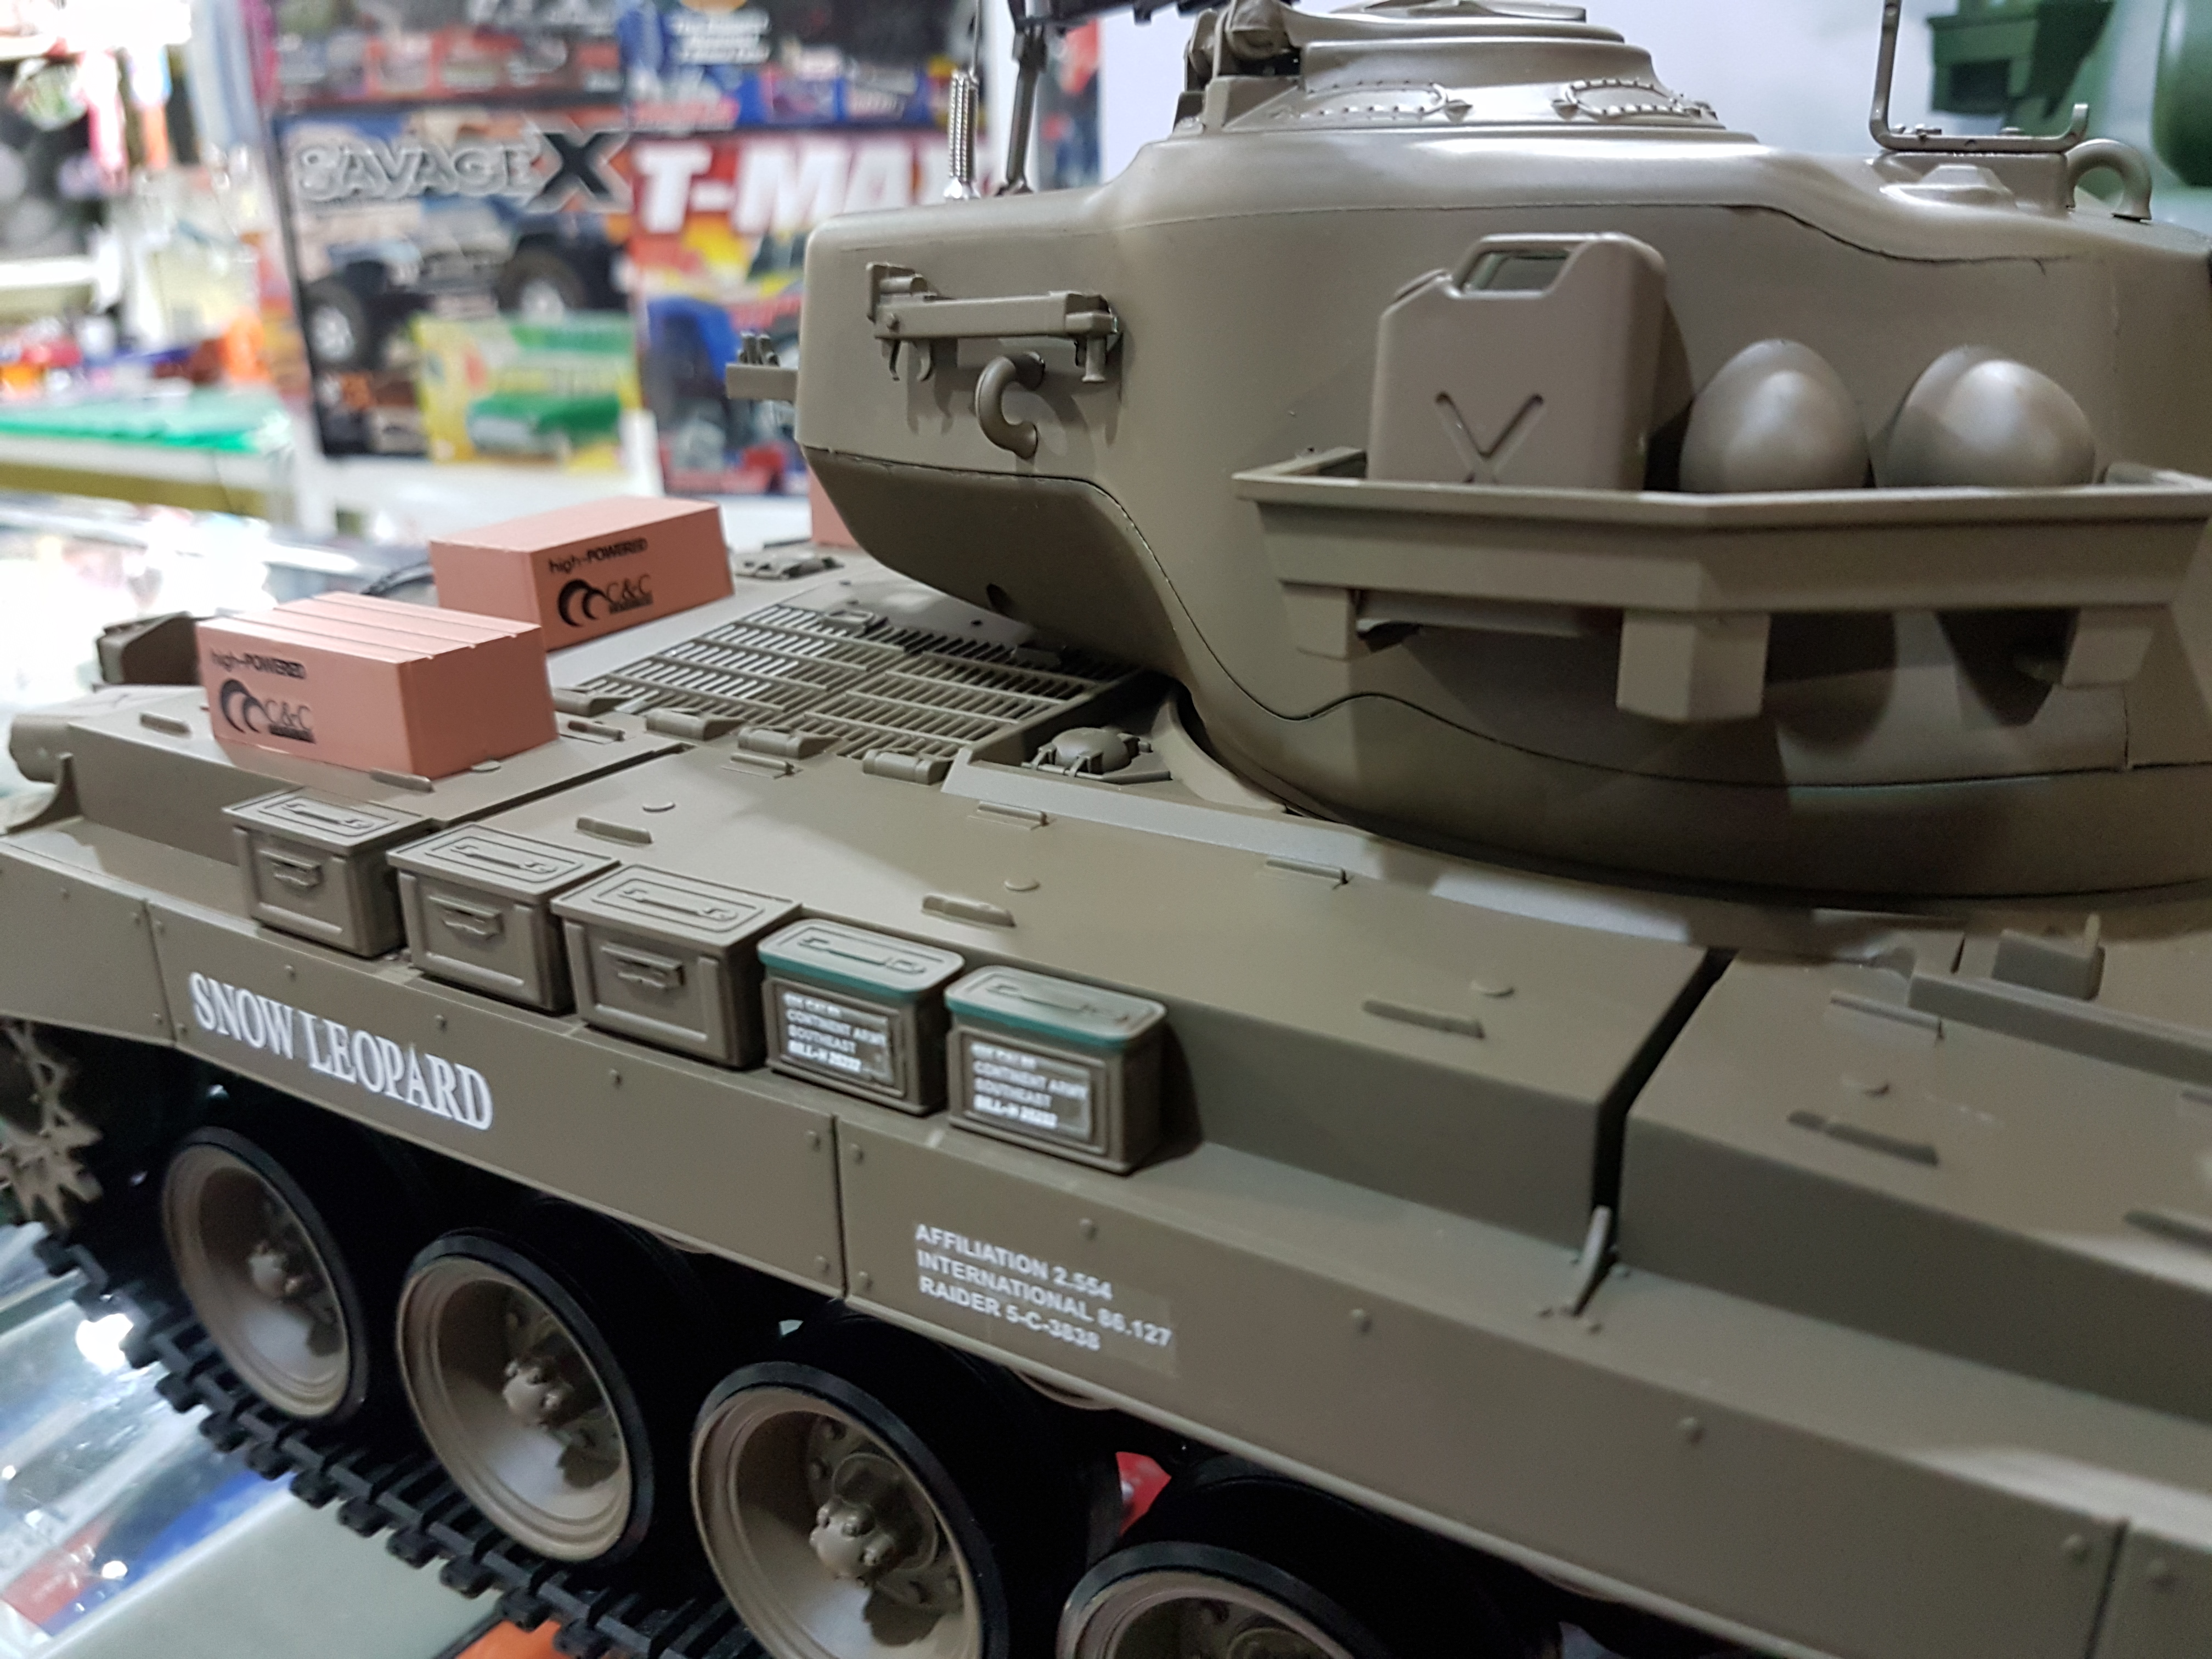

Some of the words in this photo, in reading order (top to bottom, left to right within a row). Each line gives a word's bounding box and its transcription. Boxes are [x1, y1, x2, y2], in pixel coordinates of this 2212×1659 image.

[548, 537, 648, 574] high-POWERED
[606, 573, 651, 603] C&C
[266, 699, 313, 731] C&C
[189, 972, 295, 1060] SNOW
[299, 1011, 494, 1131] LEOPARD
[915, 1224, 1049, 1281] AFFILIATION
[917, 1249, 1093, 1323] INTERNATIONAL
[919, 1276, 1001, 1317] RAIDER
